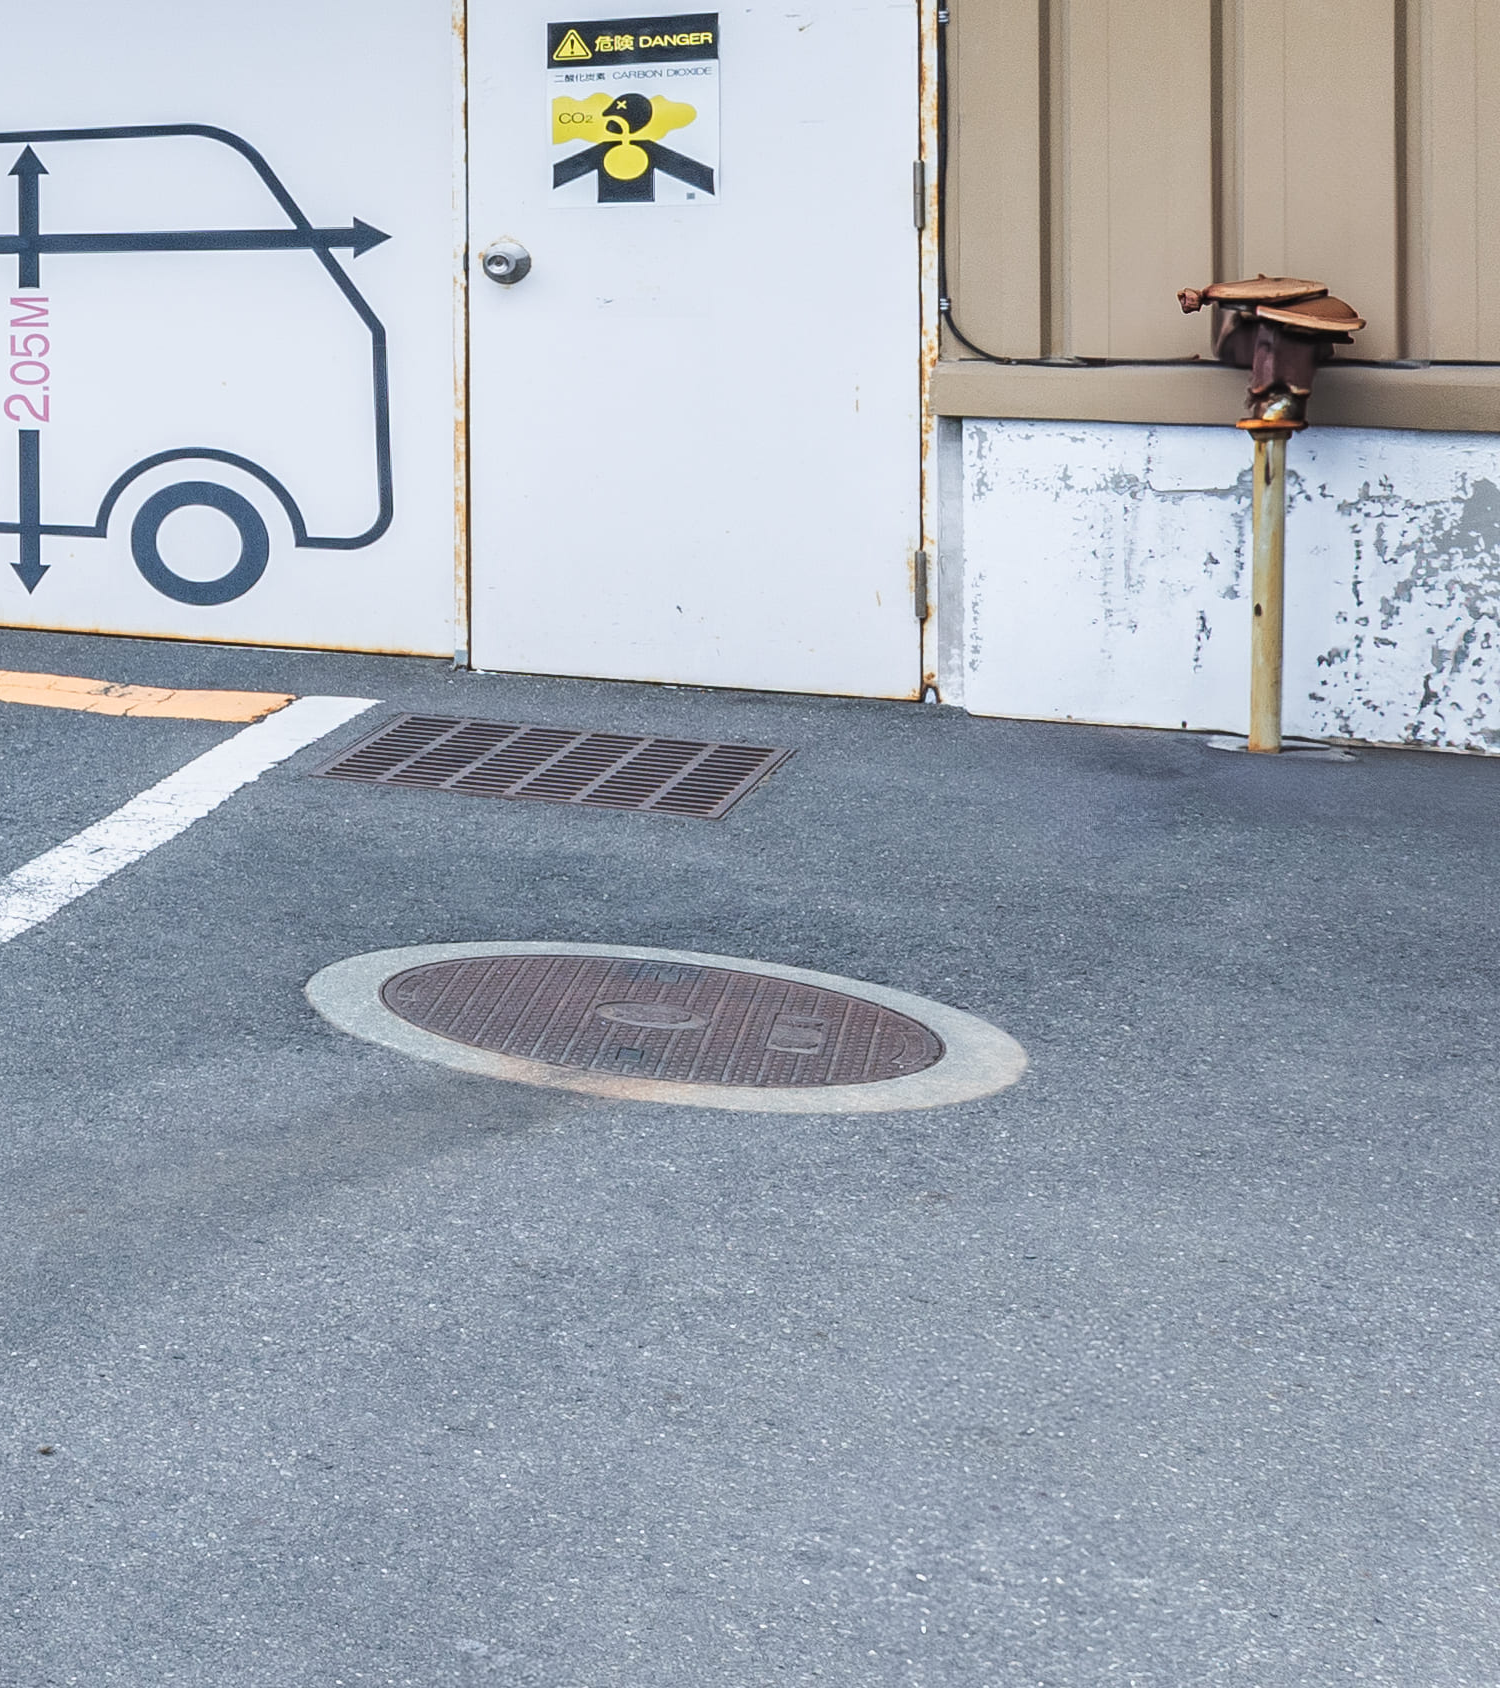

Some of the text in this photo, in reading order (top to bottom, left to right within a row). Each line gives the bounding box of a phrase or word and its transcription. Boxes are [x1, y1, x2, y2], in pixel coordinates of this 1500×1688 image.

[594, 32, 713, 52] 危険 DANGER
[554, 66, 712, 82] 二酸化炭素 CARBON DIOXIDE
[4, 295, 50, 423] 2.05M
